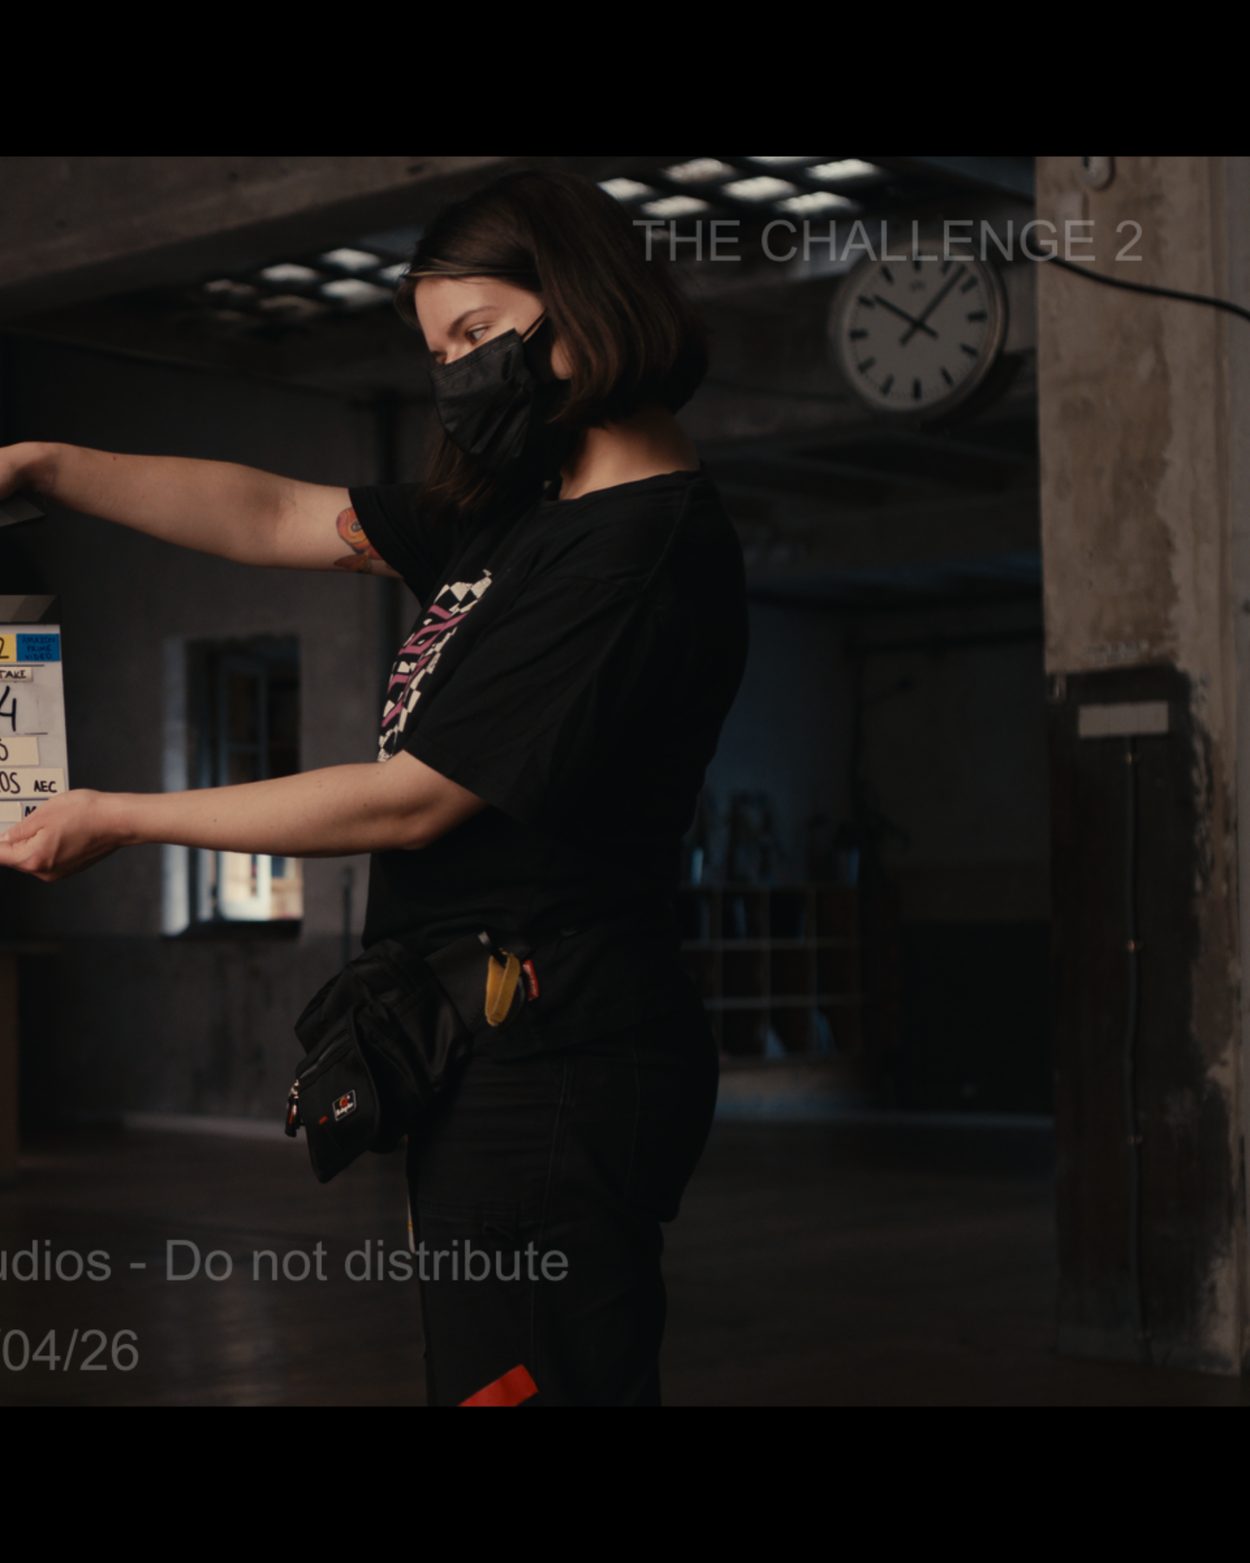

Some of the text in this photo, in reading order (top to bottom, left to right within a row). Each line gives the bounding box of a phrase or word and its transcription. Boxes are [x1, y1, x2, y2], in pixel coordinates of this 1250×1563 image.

[21, 635, 56, 644] AMAZON
[24, 652, 53, 661] VIDEO
[34, 780, 57, 793] AEC
